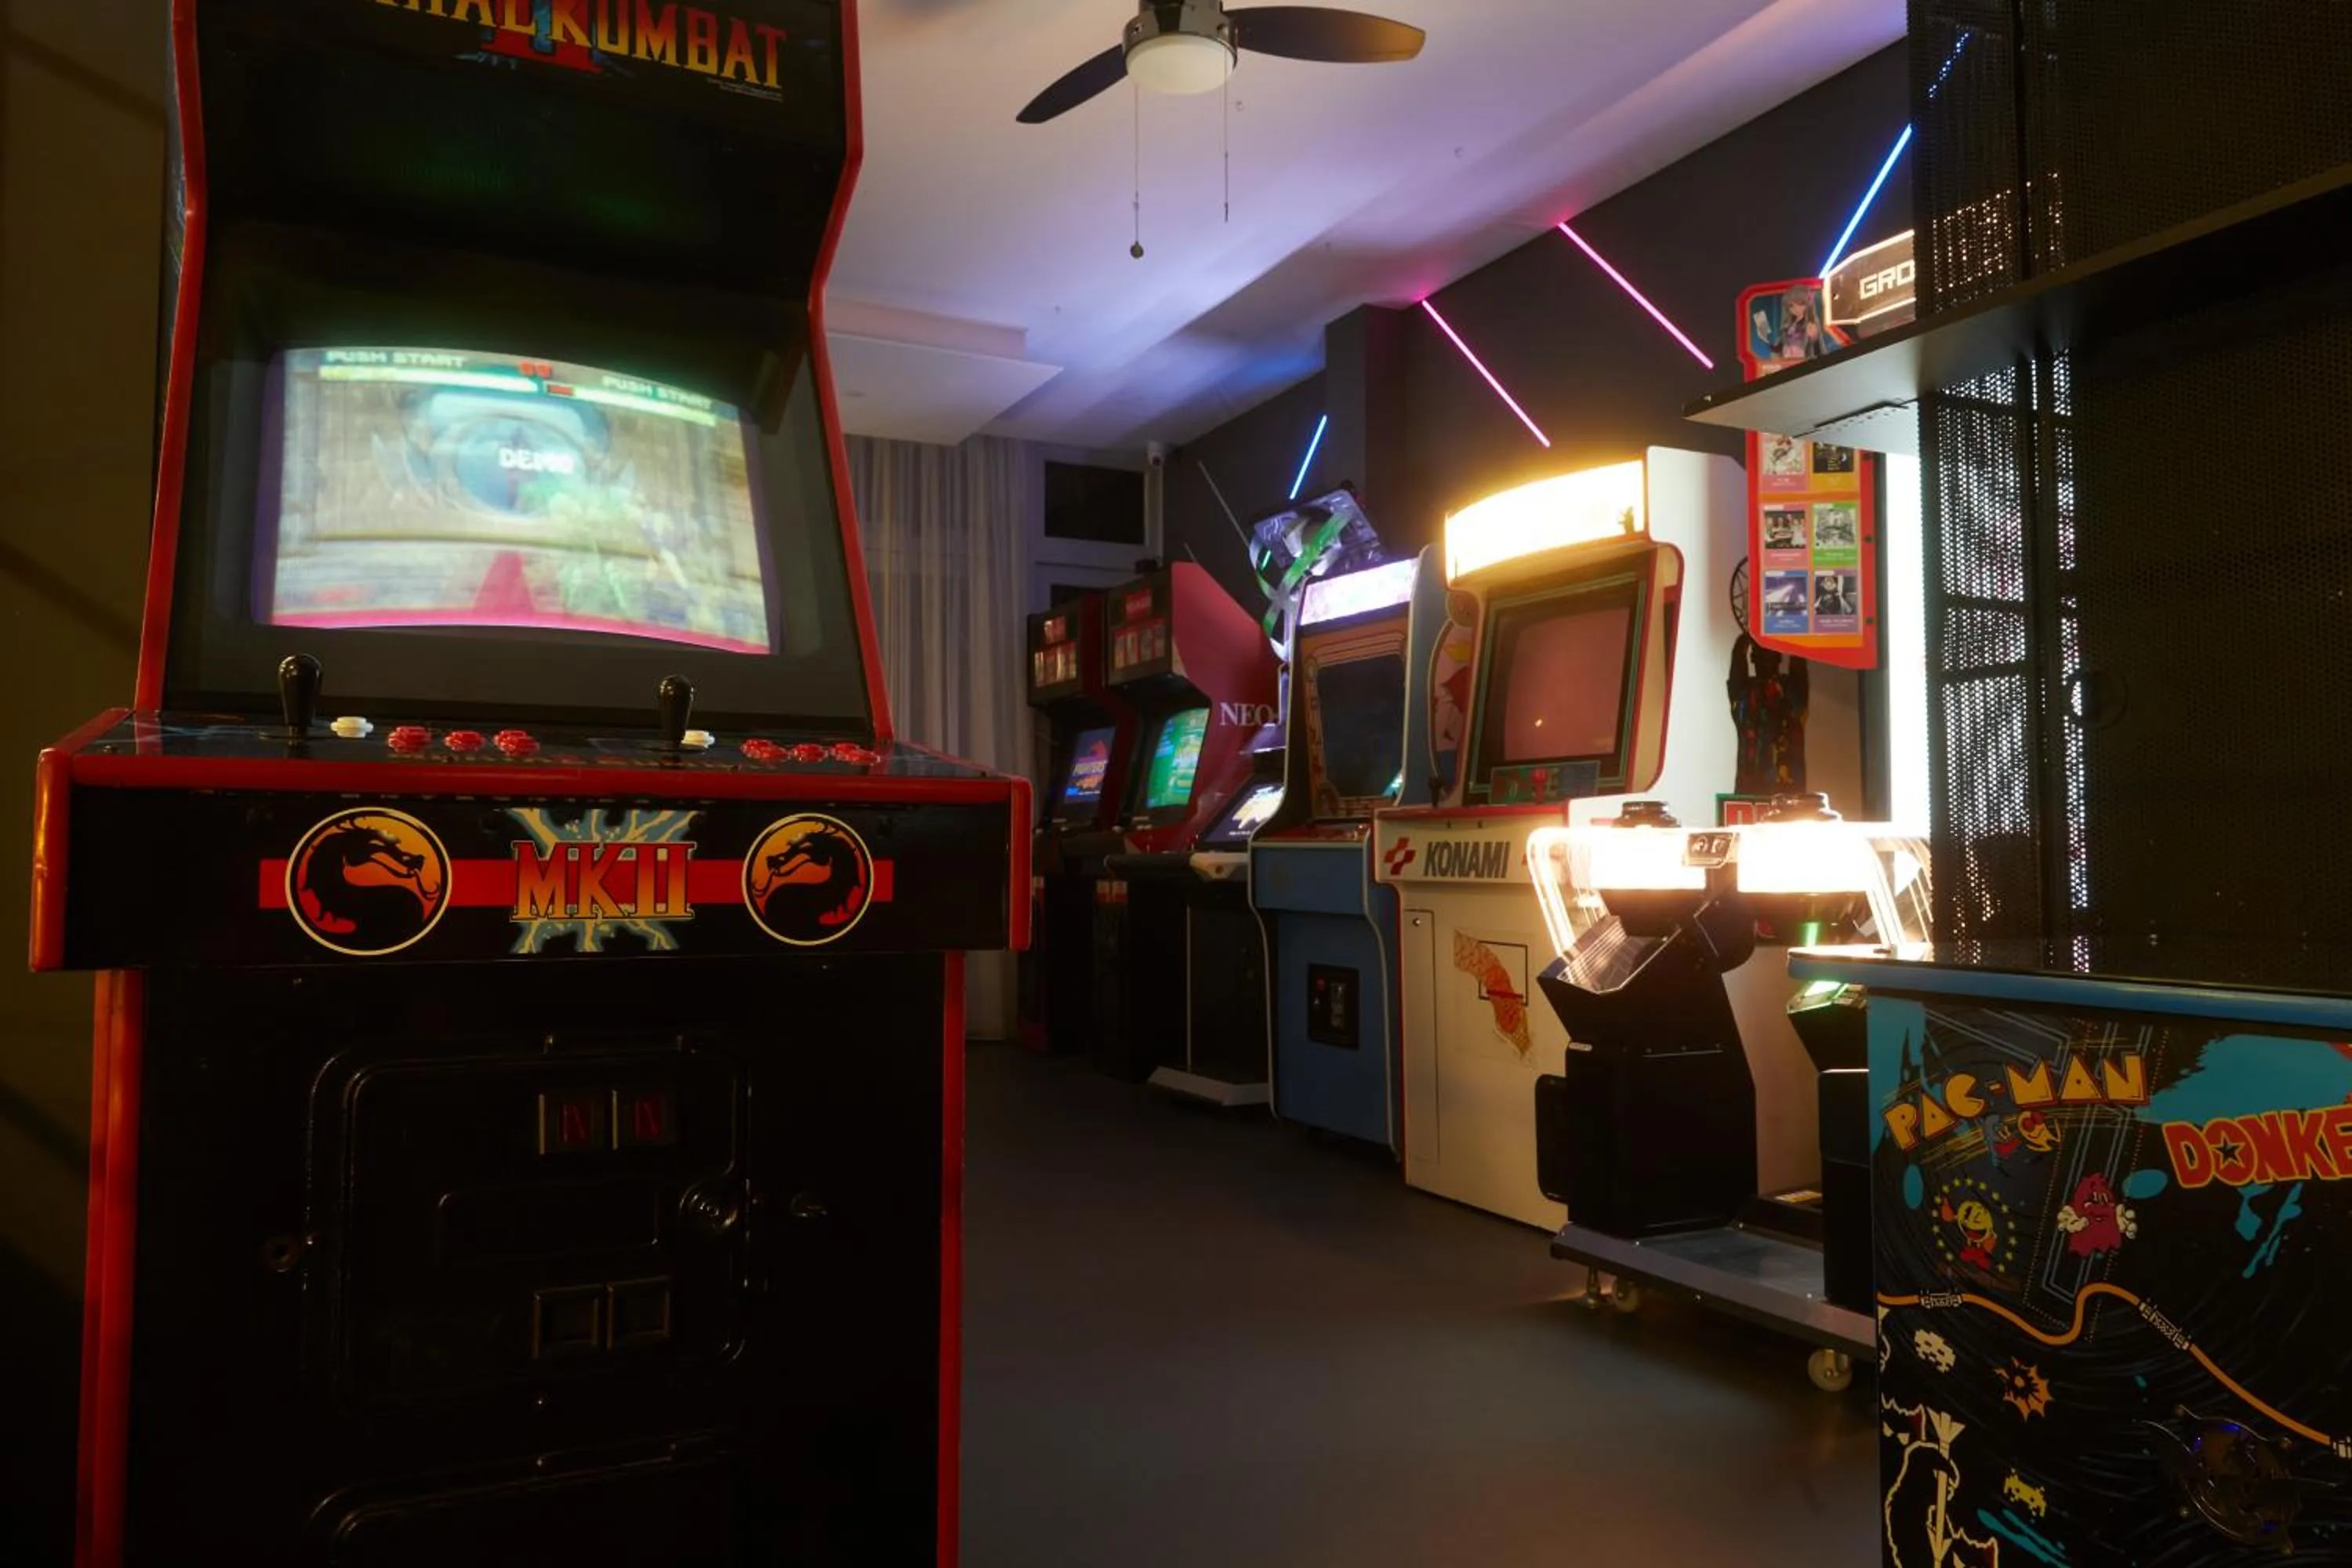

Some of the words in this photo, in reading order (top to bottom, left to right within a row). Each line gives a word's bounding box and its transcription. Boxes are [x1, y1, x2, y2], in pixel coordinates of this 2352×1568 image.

[549, 0, 787, 89] KOMBAT
[326, 350, 387, 364] PUSH
[393, 351, 466, 368] START
[499, 447, 573, 474] DEMO
[1423, 840, 1511, 879] KONAMI
[1882, 1053, 2150, 1152] PAC-MAN
